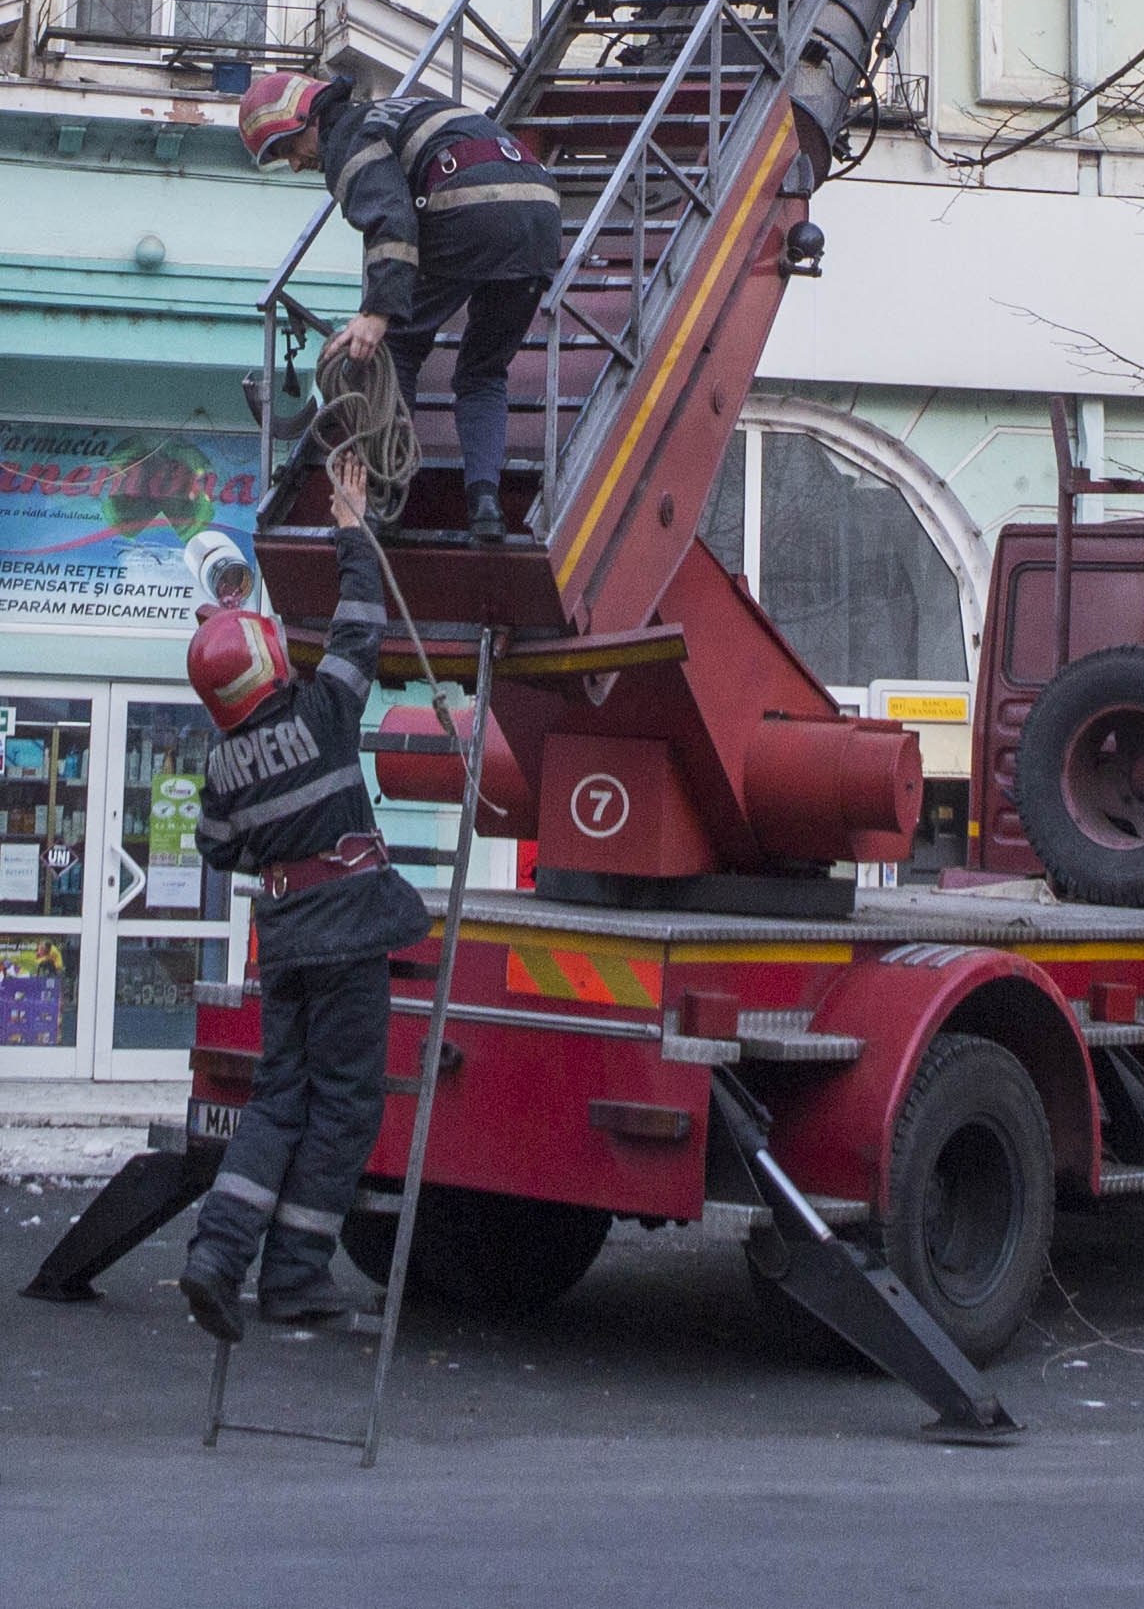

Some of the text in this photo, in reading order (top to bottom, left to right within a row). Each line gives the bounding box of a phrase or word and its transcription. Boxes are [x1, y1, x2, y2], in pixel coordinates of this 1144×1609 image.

[0, 560, 60, 576] BERĂM
[113, 583, 194, 599] GRATUITE
[70, 602, 191, 620] MEDICAMENTE
[589, 790, 612, 822] 7
[48, 849, 71, 866] UNI
